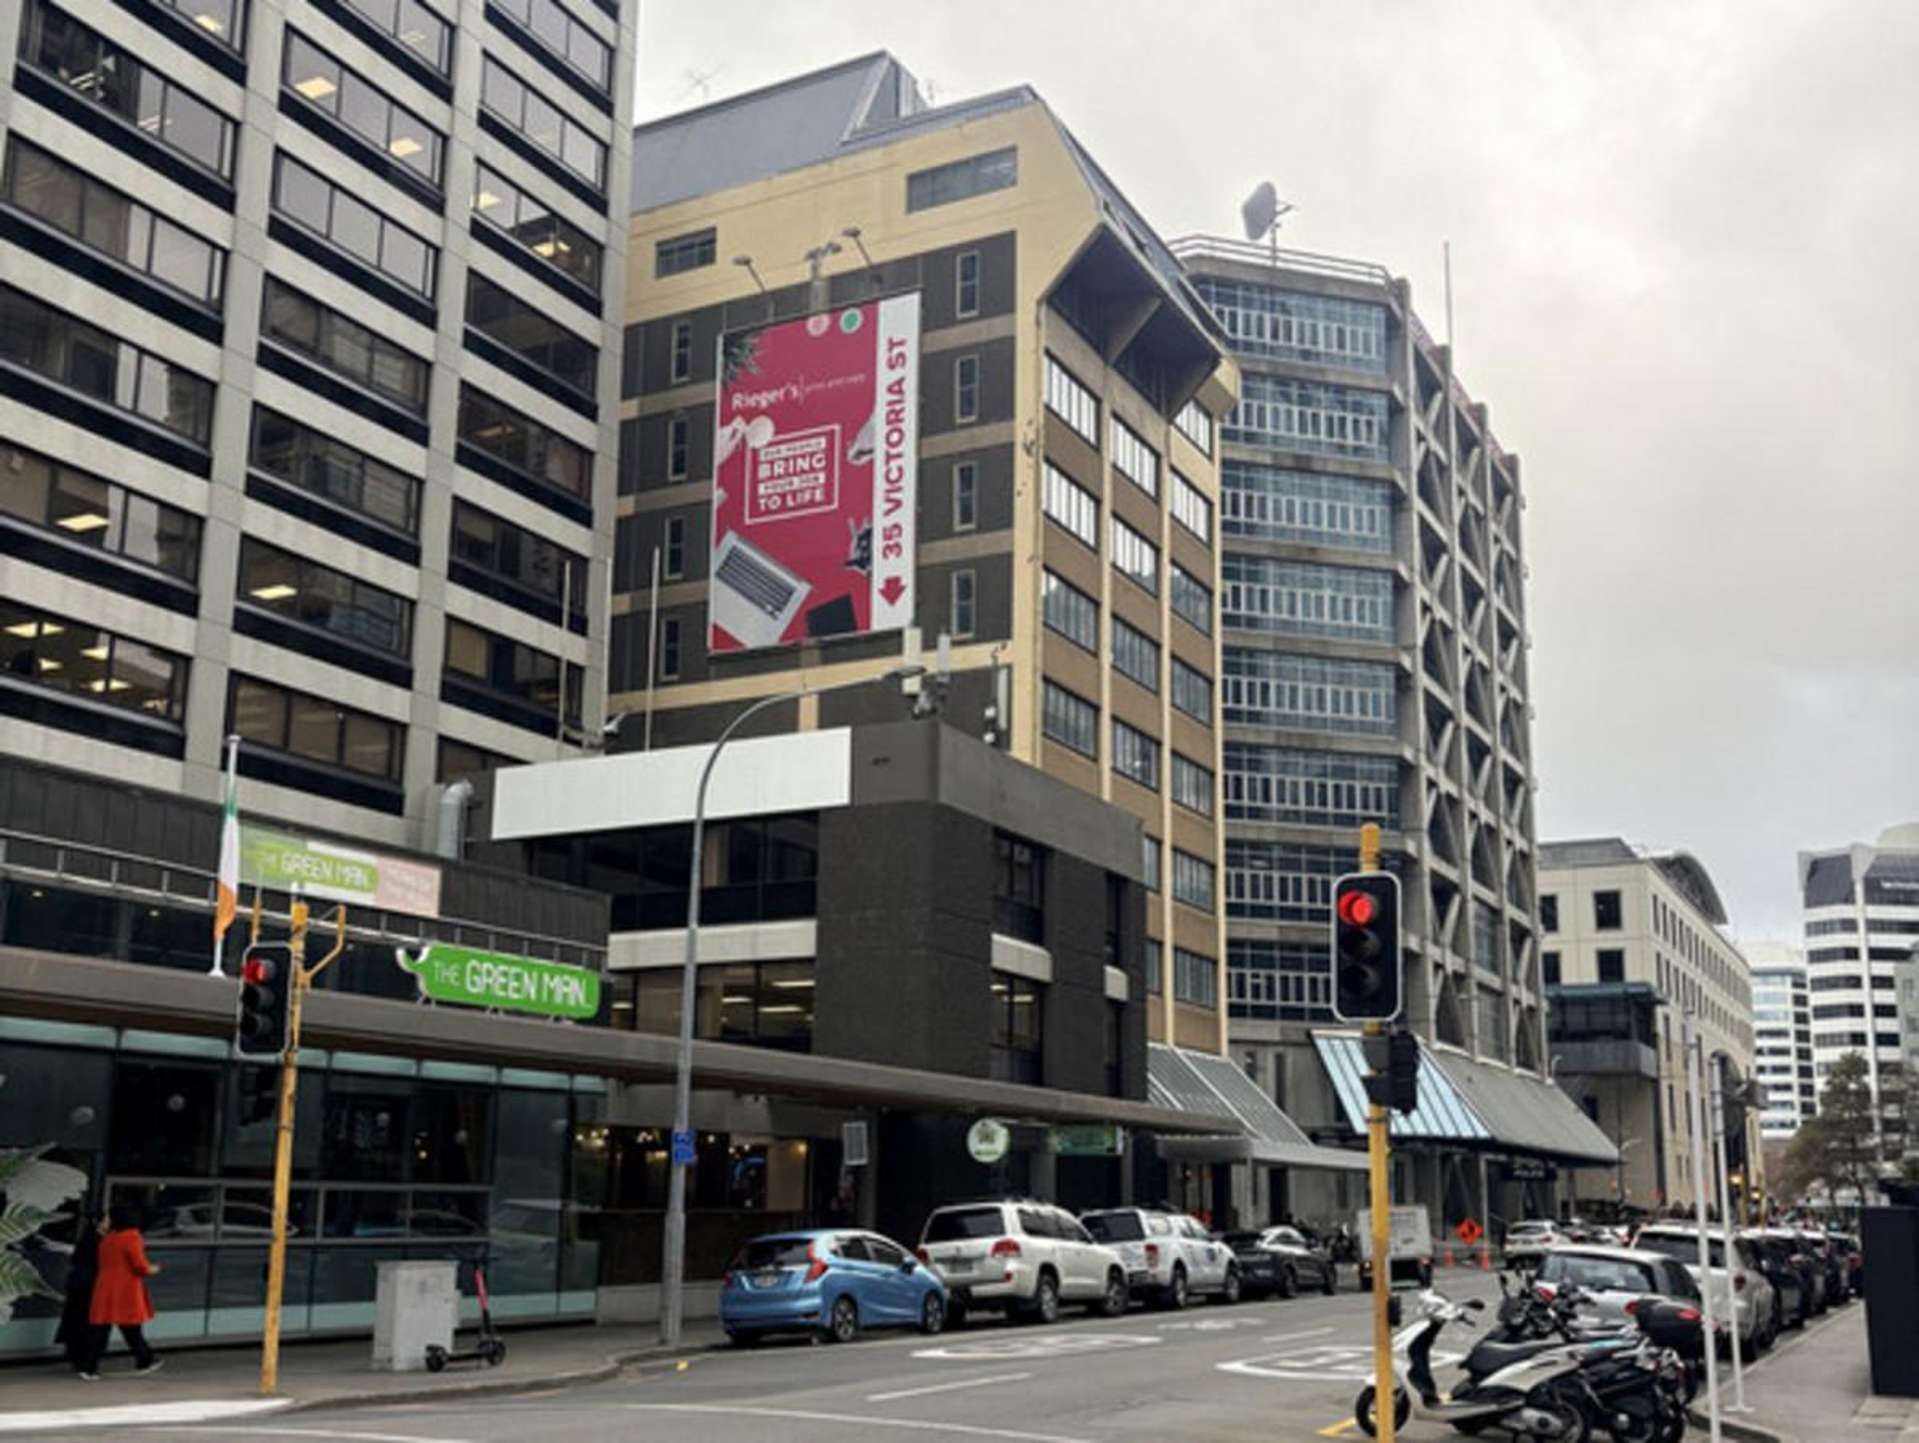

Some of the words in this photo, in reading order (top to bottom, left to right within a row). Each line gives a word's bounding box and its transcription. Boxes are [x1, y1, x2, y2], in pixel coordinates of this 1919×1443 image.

[886, 337, 907, 371] ST
[732, 385, 798, 411] Rieger's
[883, 376, 906, 517] VICTORIA
[759, 454, 826, 480] BRING
[759, 494, 781, 511] TO
[786, 487, 824, 507] LIFE
[882, 523, 903, 559] 35
[280, 851, 333, 880] GREEN
[335, 862, 369, 889] MAN
[433, 961, 461, 986] THE
[465, 959, 537, 1001] GREEN
[543, 972, 586, 1006] MAN
